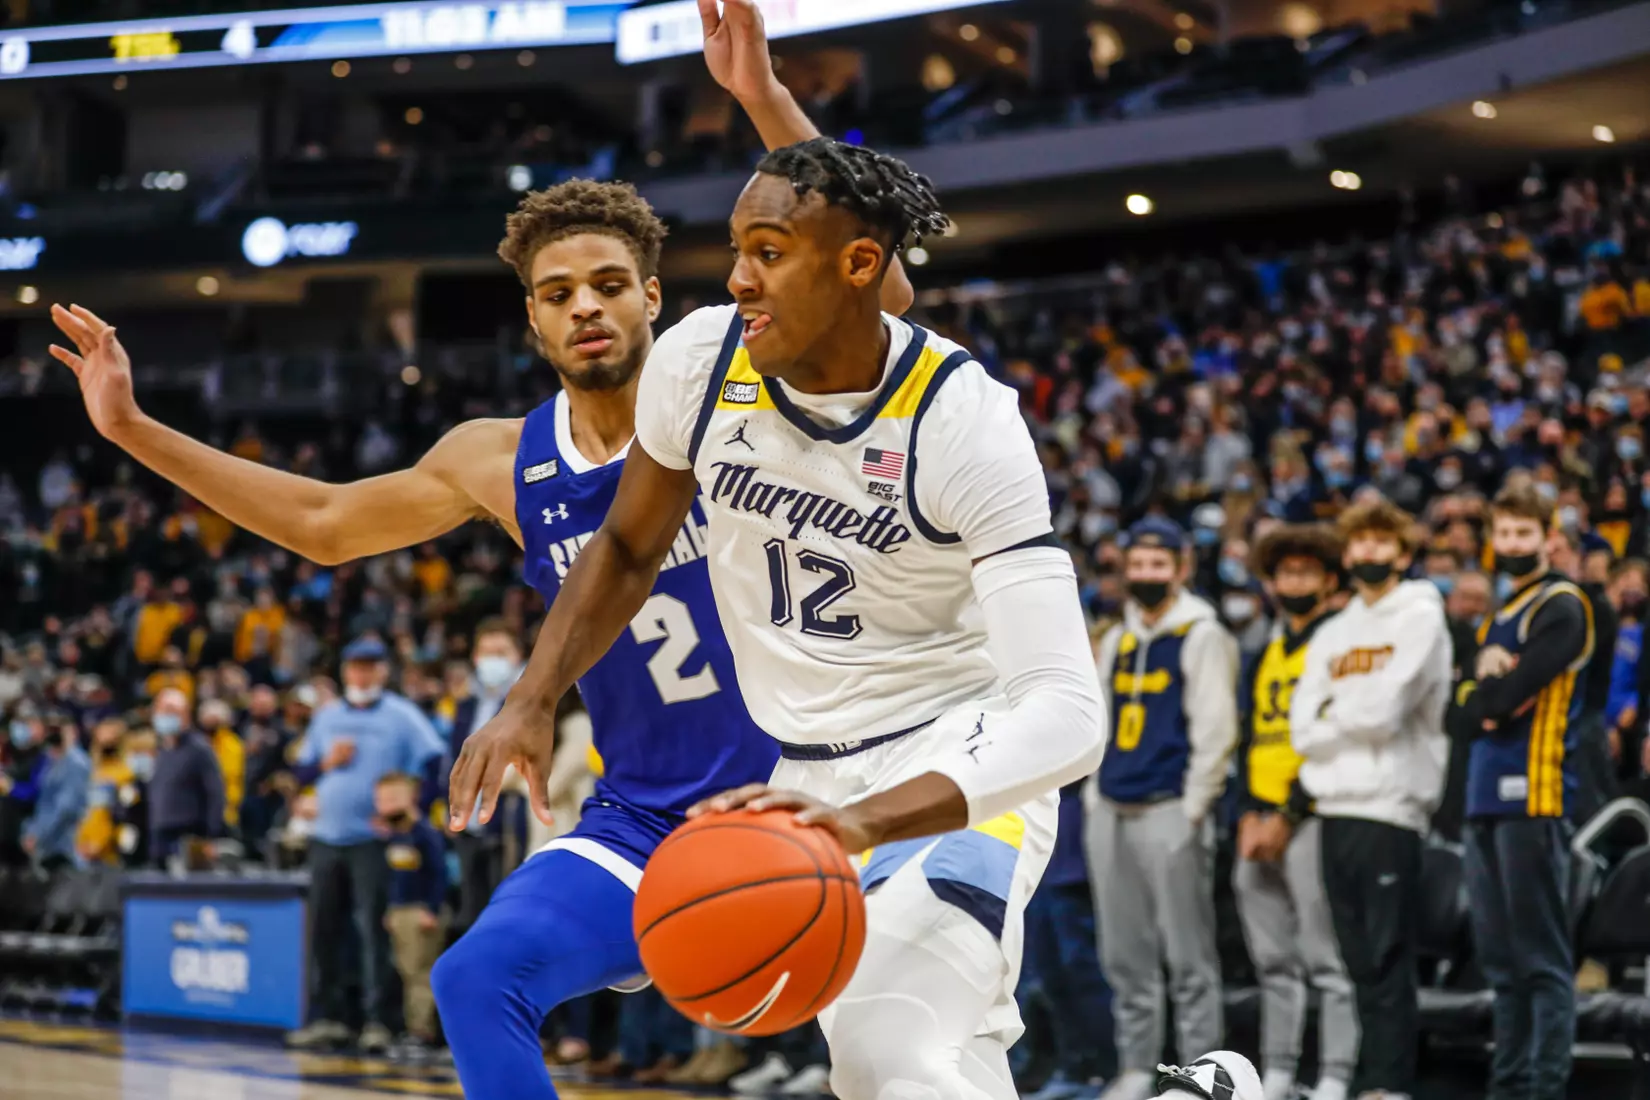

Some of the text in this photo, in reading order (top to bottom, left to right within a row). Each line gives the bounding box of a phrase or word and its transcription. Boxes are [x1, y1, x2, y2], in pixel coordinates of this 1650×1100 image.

[710, 461, 911, 553] Marquette
[868, 481, 896, 493] BIG
[764, 538, 863, 640] 12
[629, 592, 721, 705] 2
